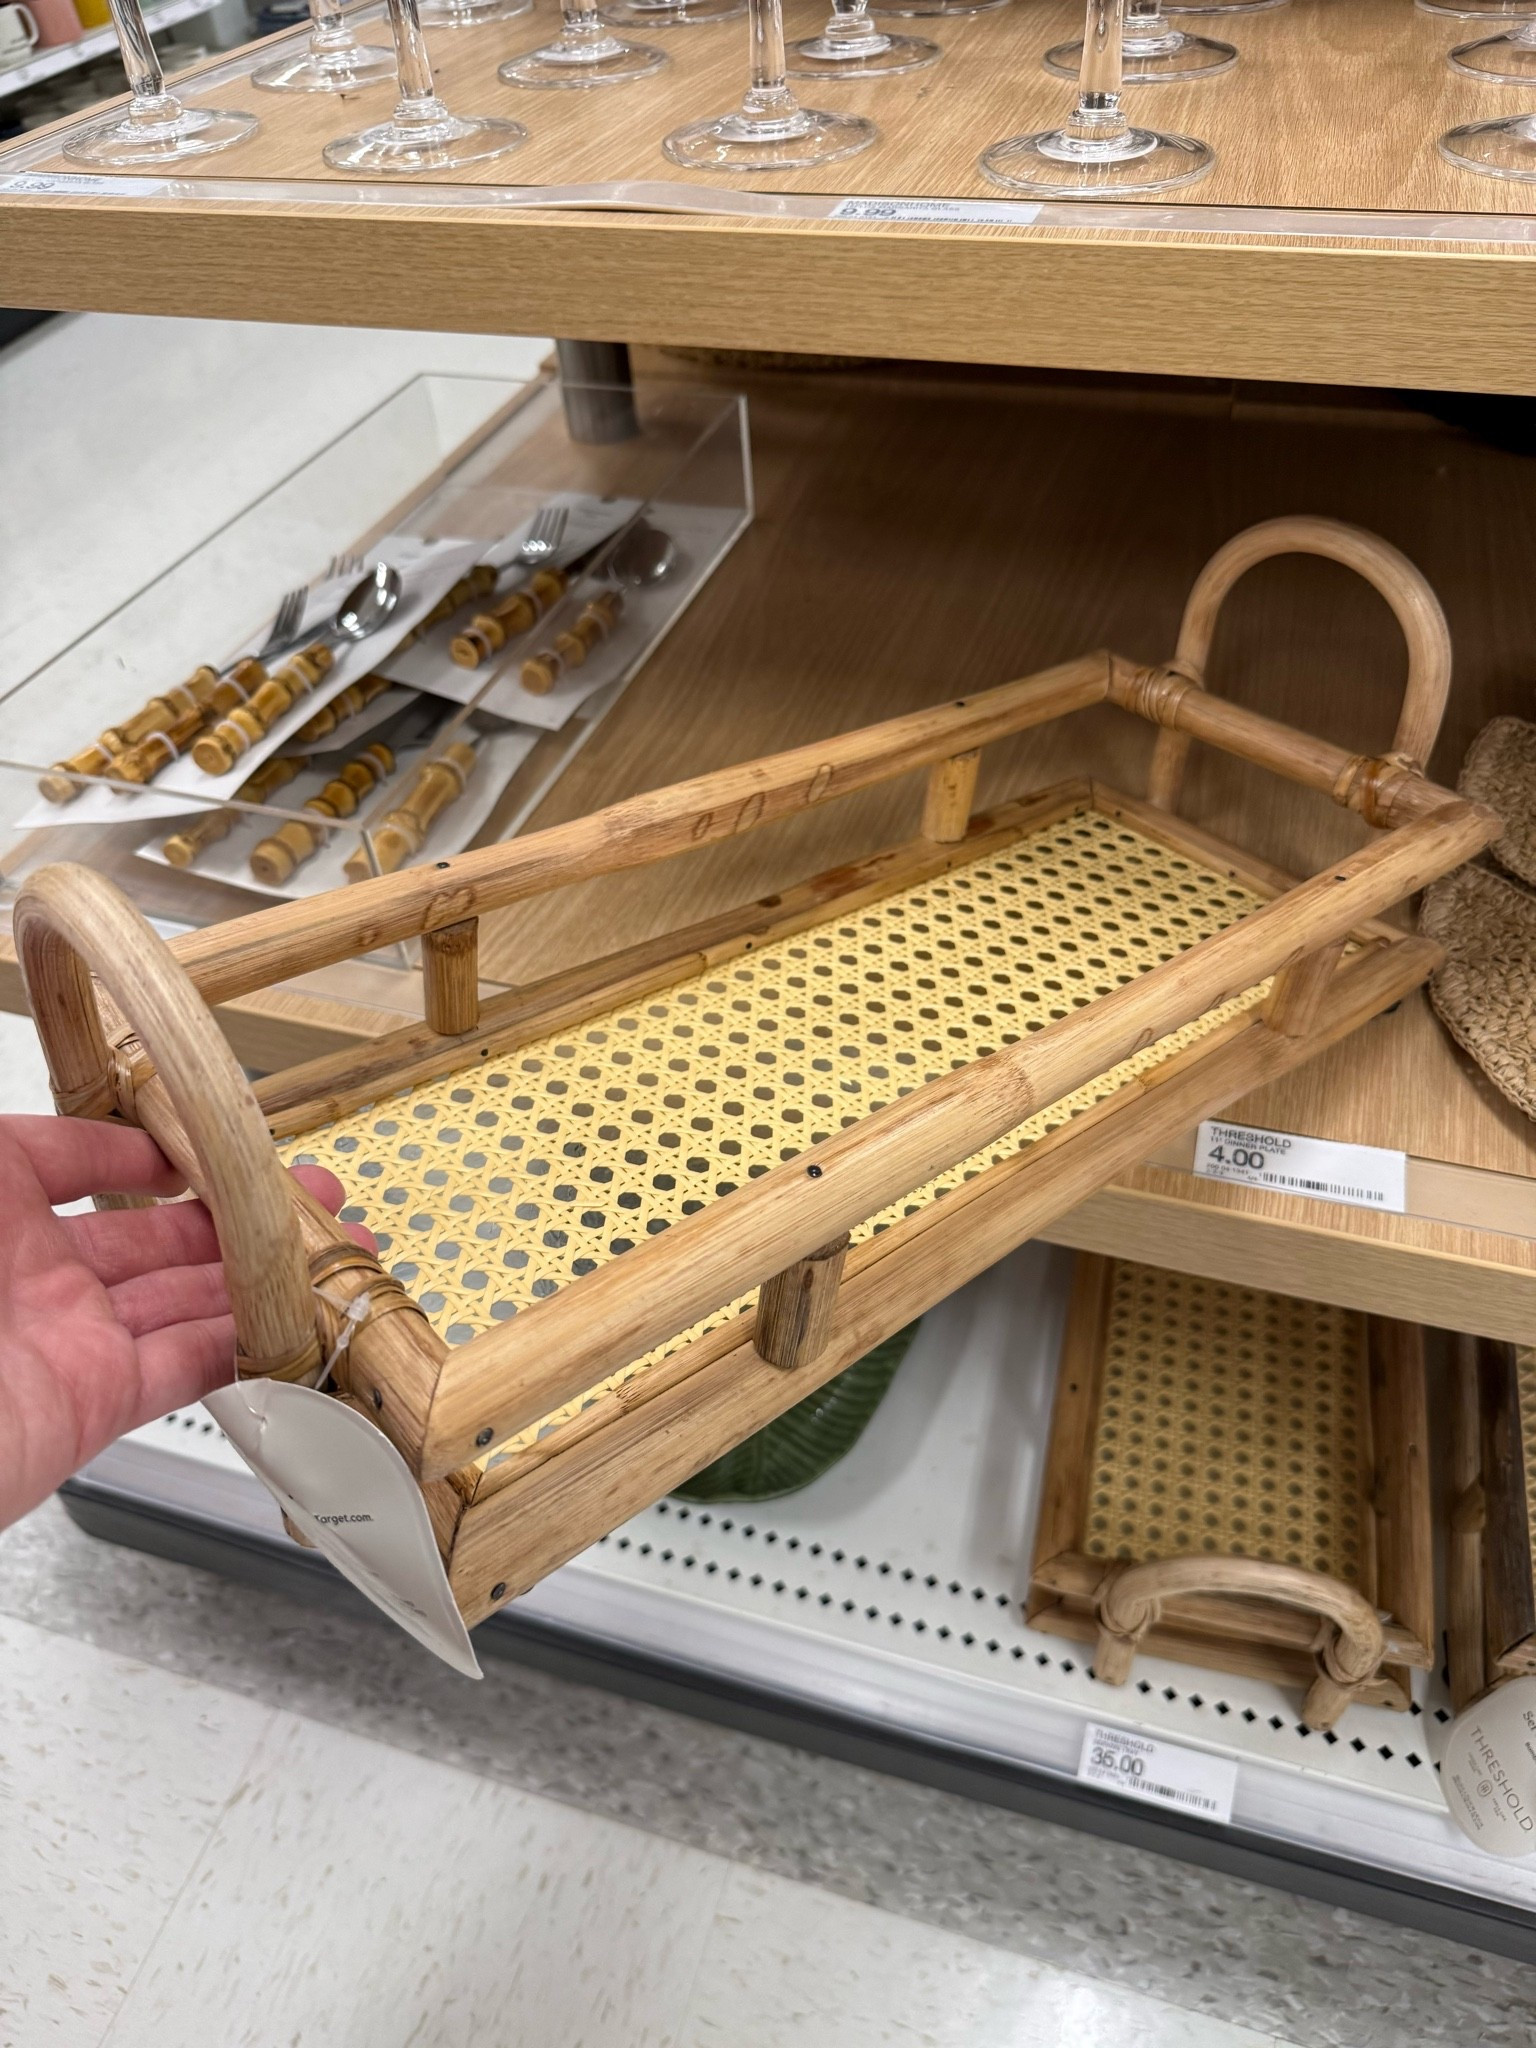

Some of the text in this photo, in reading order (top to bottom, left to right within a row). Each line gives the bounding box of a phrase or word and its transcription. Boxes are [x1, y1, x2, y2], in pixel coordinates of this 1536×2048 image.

[840, 208, 897, 217] 9.99
[1210, 1126, 1292, 1149] THRESHOLD
[1224, 1138, 1257, 1150] DINNER
[1258, 1145, 1287, 1155] PLATE
[1208, 1144, 1265, 1169] 4.00
[1470, 1725, 1534, 1832] THRESHOLD
